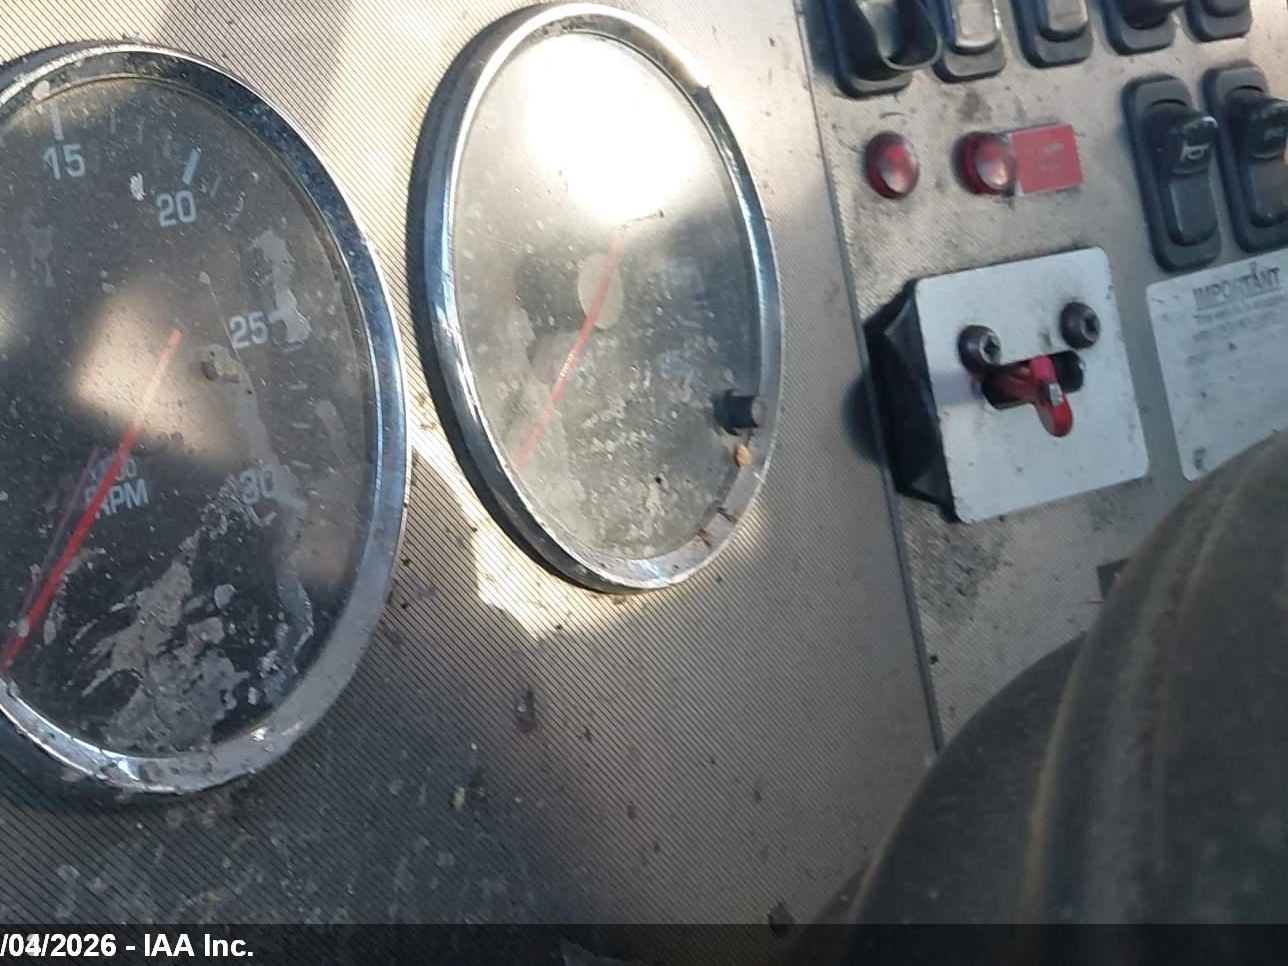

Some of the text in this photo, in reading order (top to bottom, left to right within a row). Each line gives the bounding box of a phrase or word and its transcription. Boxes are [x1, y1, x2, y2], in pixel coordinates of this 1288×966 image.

[44, 142, 86, 180] 15
[157, 190, 197, 229] 20
[230, 314, 269, 350] 25
[83, 477, 151, 518] RPM
[239, 466, 279, 506] 30
